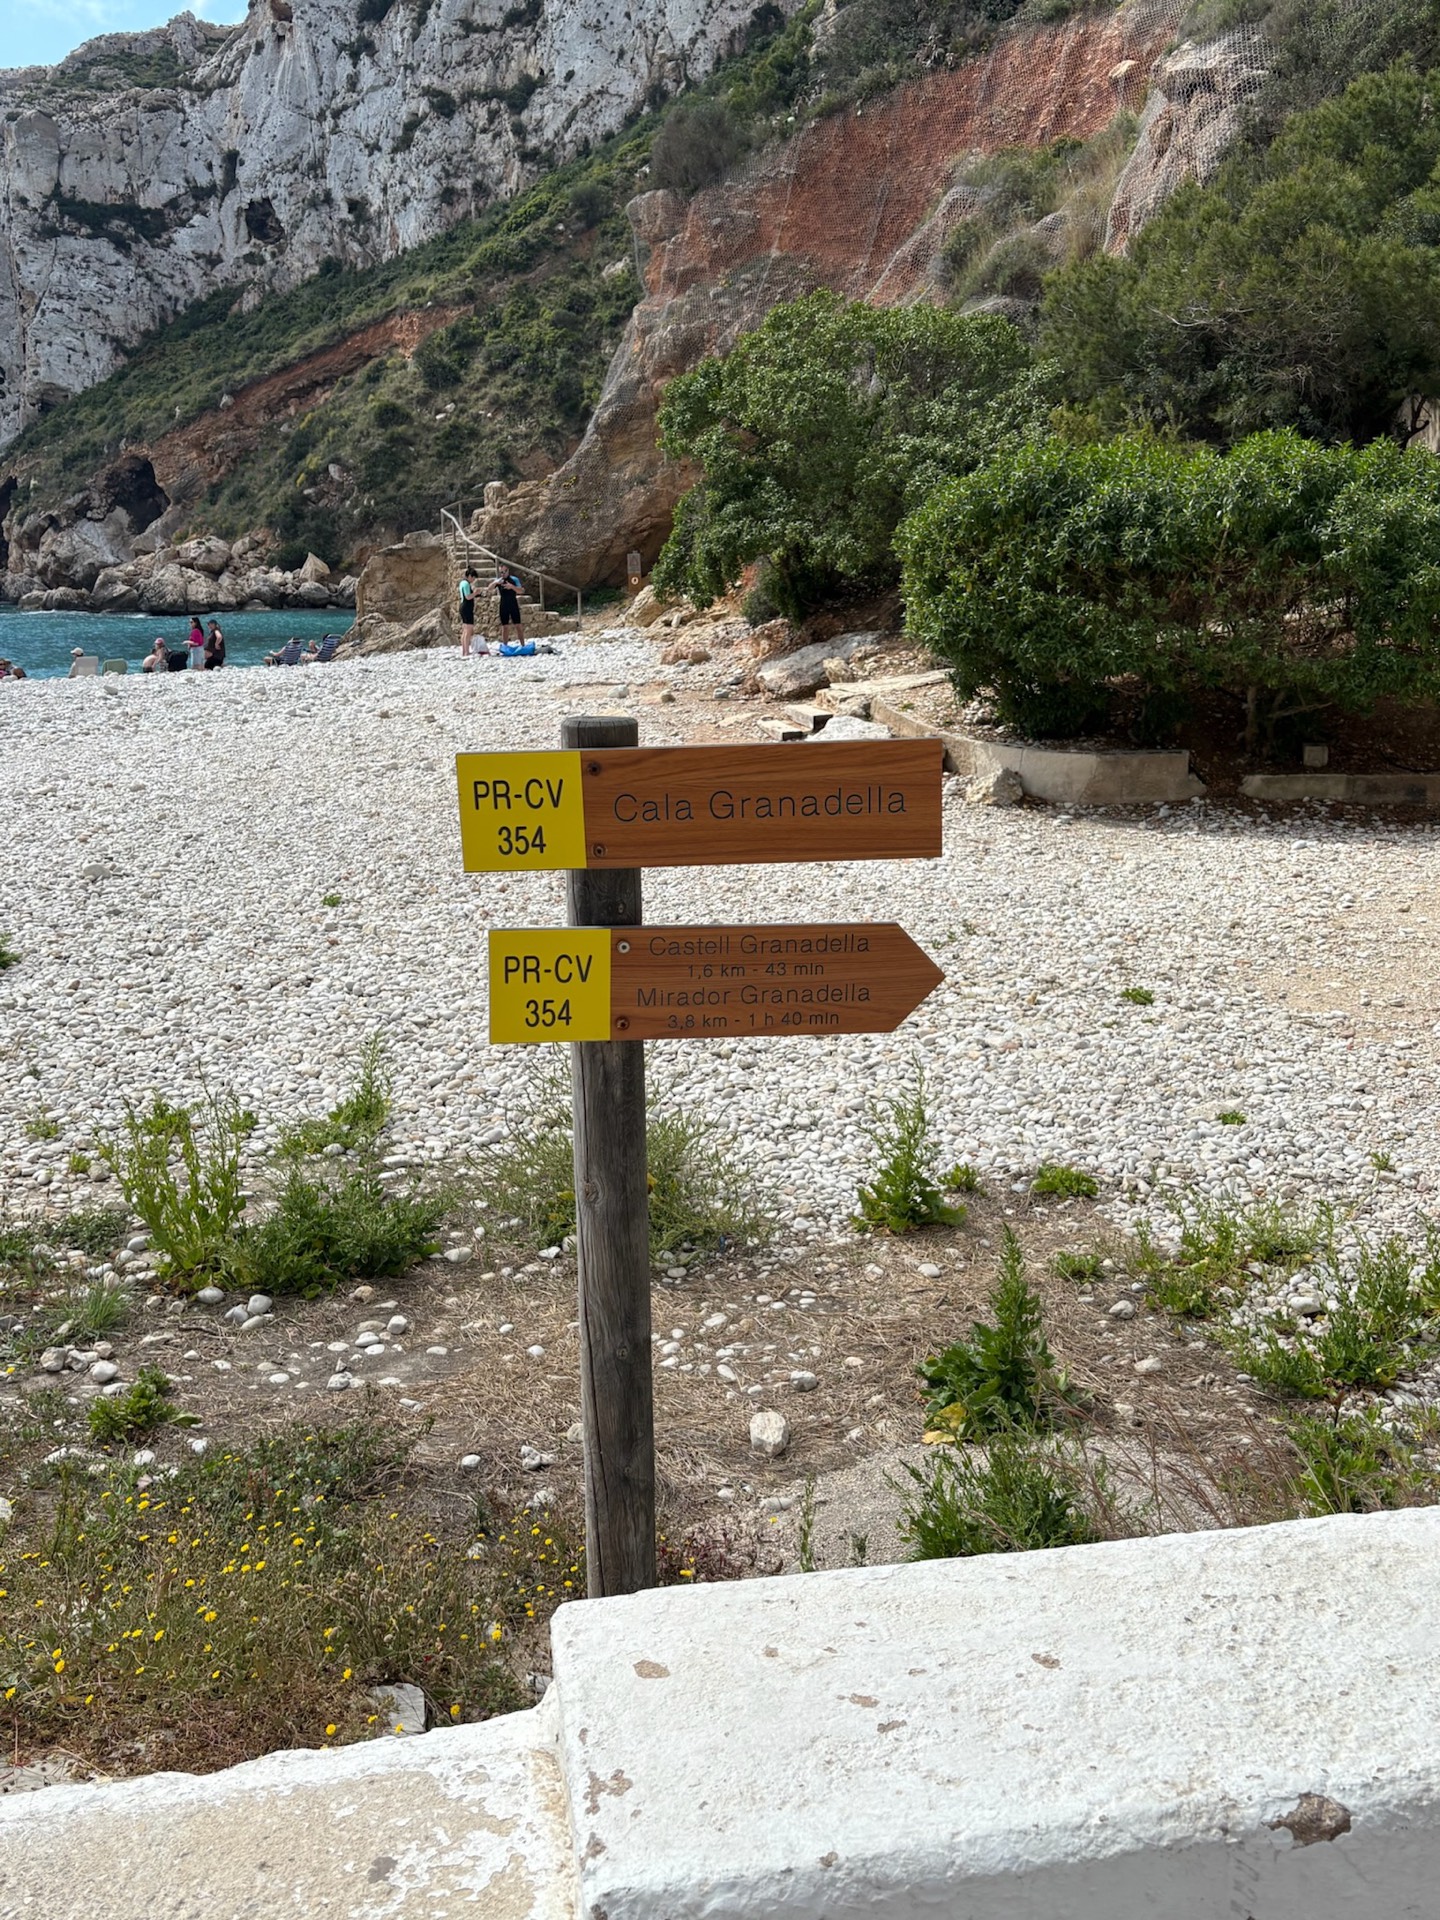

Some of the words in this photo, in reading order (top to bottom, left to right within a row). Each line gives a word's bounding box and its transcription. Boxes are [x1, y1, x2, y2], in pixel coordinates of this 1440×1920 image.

[473, 778, 563, 810] PR-CV
[613, 793, 694, 822] Cala
[709, 786, 907, 819] Granadella
[497, 825, 546, 855] 354
[649, 935, 729, 956] Castell
[740, 933, 870, 954] Granadella
[504, 954, 593, 984] PR-CV
[688, 964, 713, 980] 1,6
[720, 963, 745, 977] km
[765, 962, 786, 976] 43
[794, 962, 824, 975] min
[637, 987, 731, 1007] Mirador
[740, 983, 870, 1005] Granadella
[524, 998, 572, 1028] 354
[667, 1014, 695, 1030] 3,8
[702, 1014, 727, 1028] km
[749, 1013, 754, 1027] 1
[764, 1012, 774, 1026] h
[781, 1011, 802, 1026] 40
[809, 1012, 839, 1025] min
